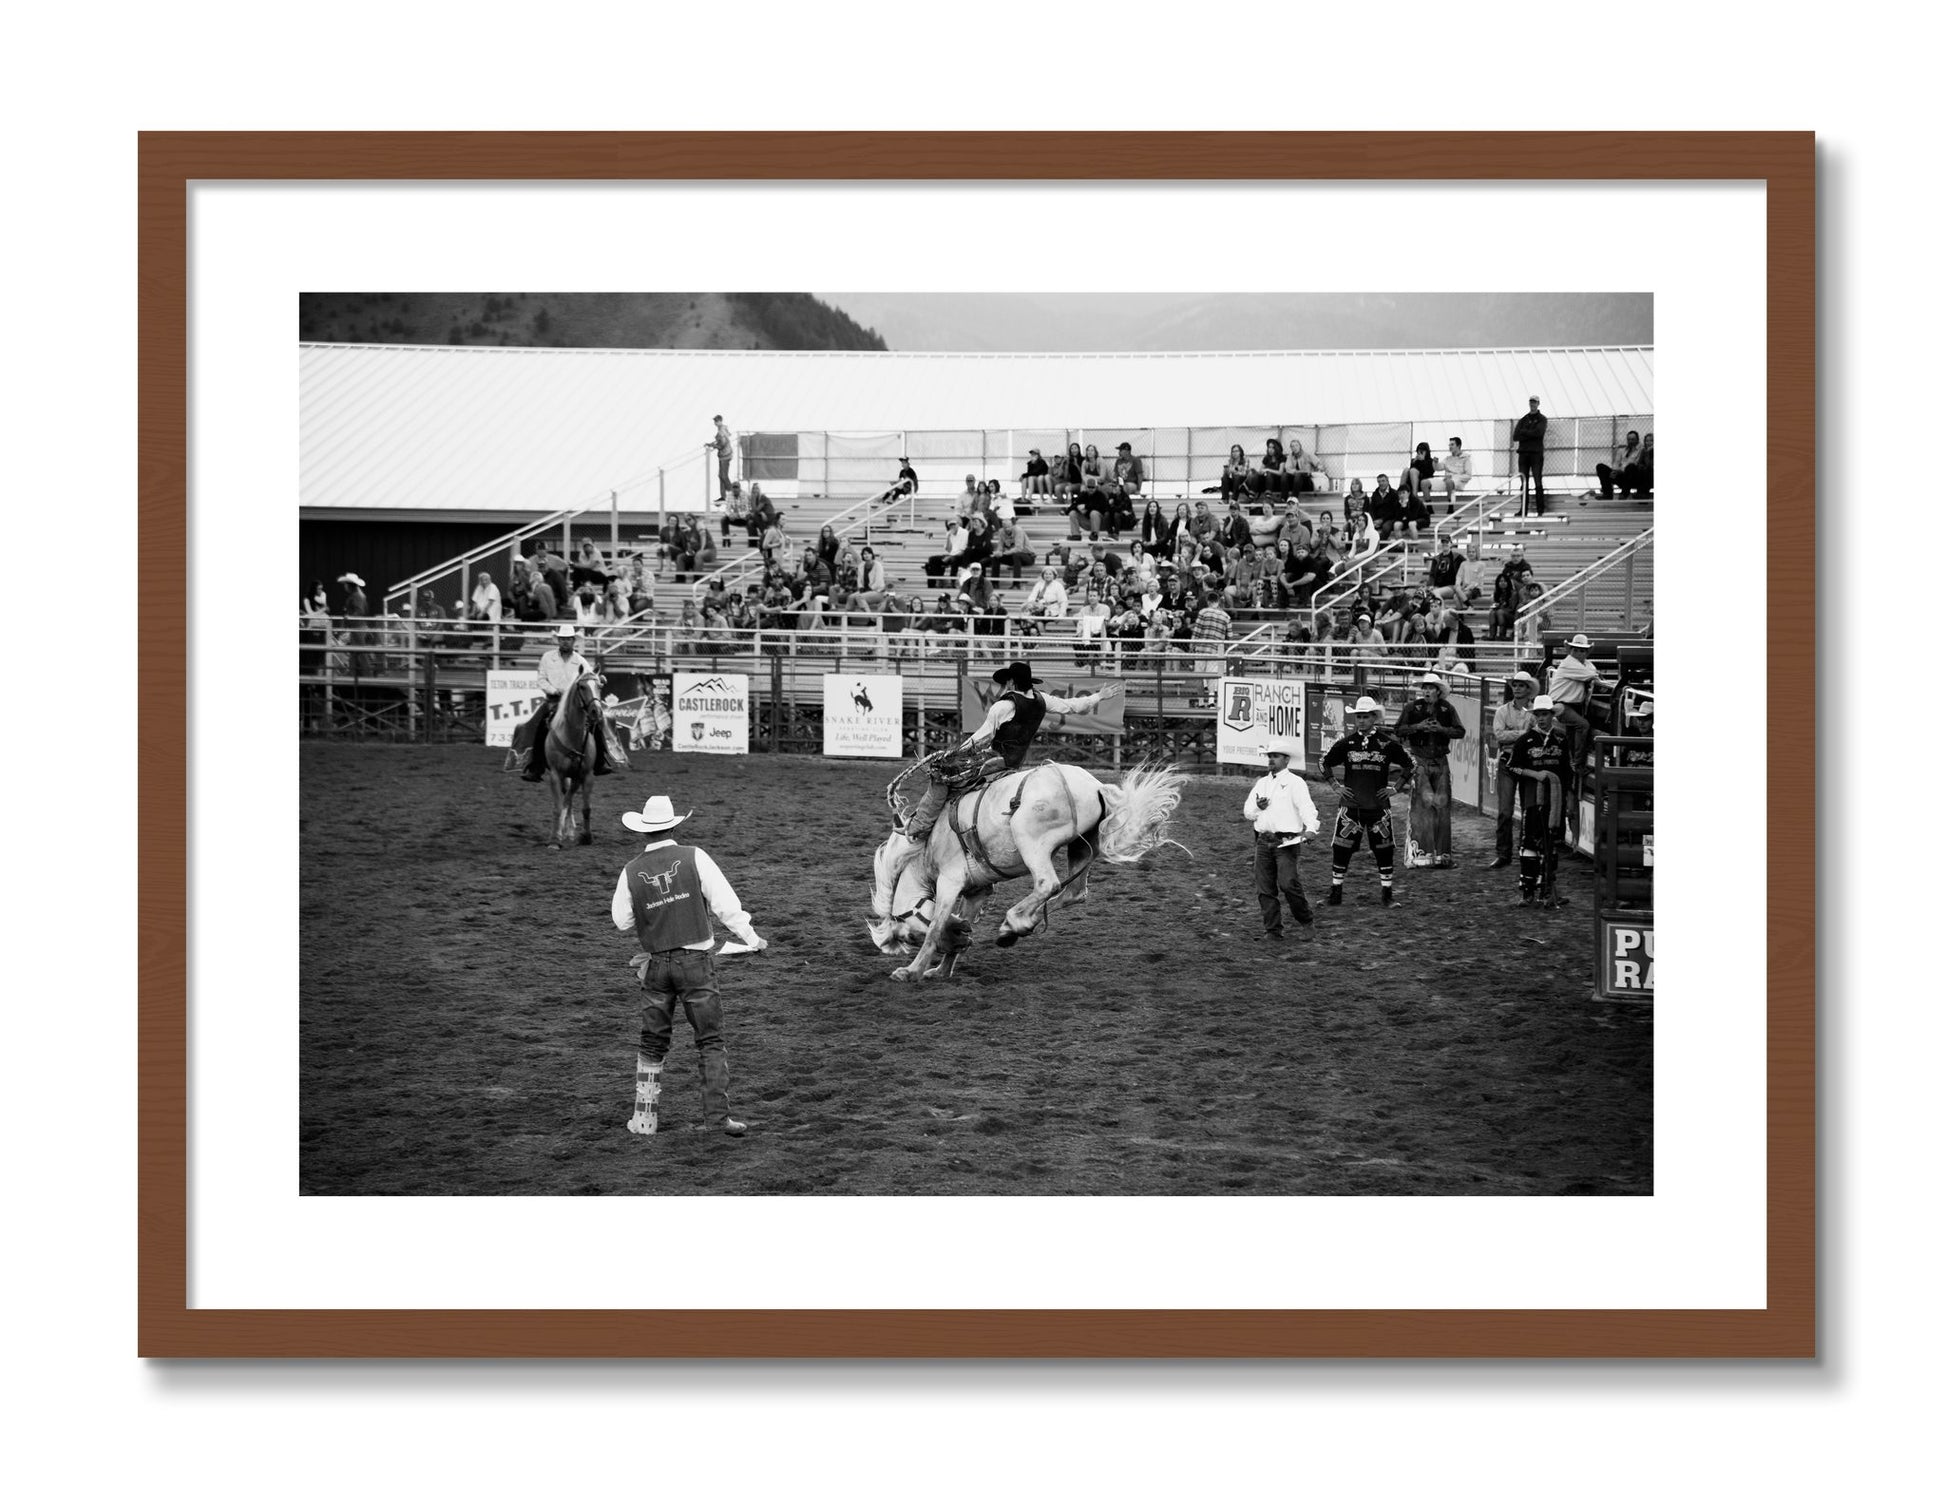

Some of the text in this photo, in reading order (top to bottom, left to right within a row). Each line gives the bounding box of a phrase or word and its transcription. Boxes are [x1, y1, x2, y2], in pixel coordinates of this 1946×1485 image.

[1233, 686, 1250, 695] BIG
[1255, 684, 1301, 705] RANCH
[679, 697, 744, 712] CASTLEROCK
[1228, 695, 1252, 721] R
[824, 716, 900, 725] SNAKE RIVER
[1269, 705, 1301, 738] HOME
[709, 727, 732, 740] Jeep
[646, 892, 690, 910] Jackson Hole Rodeo
